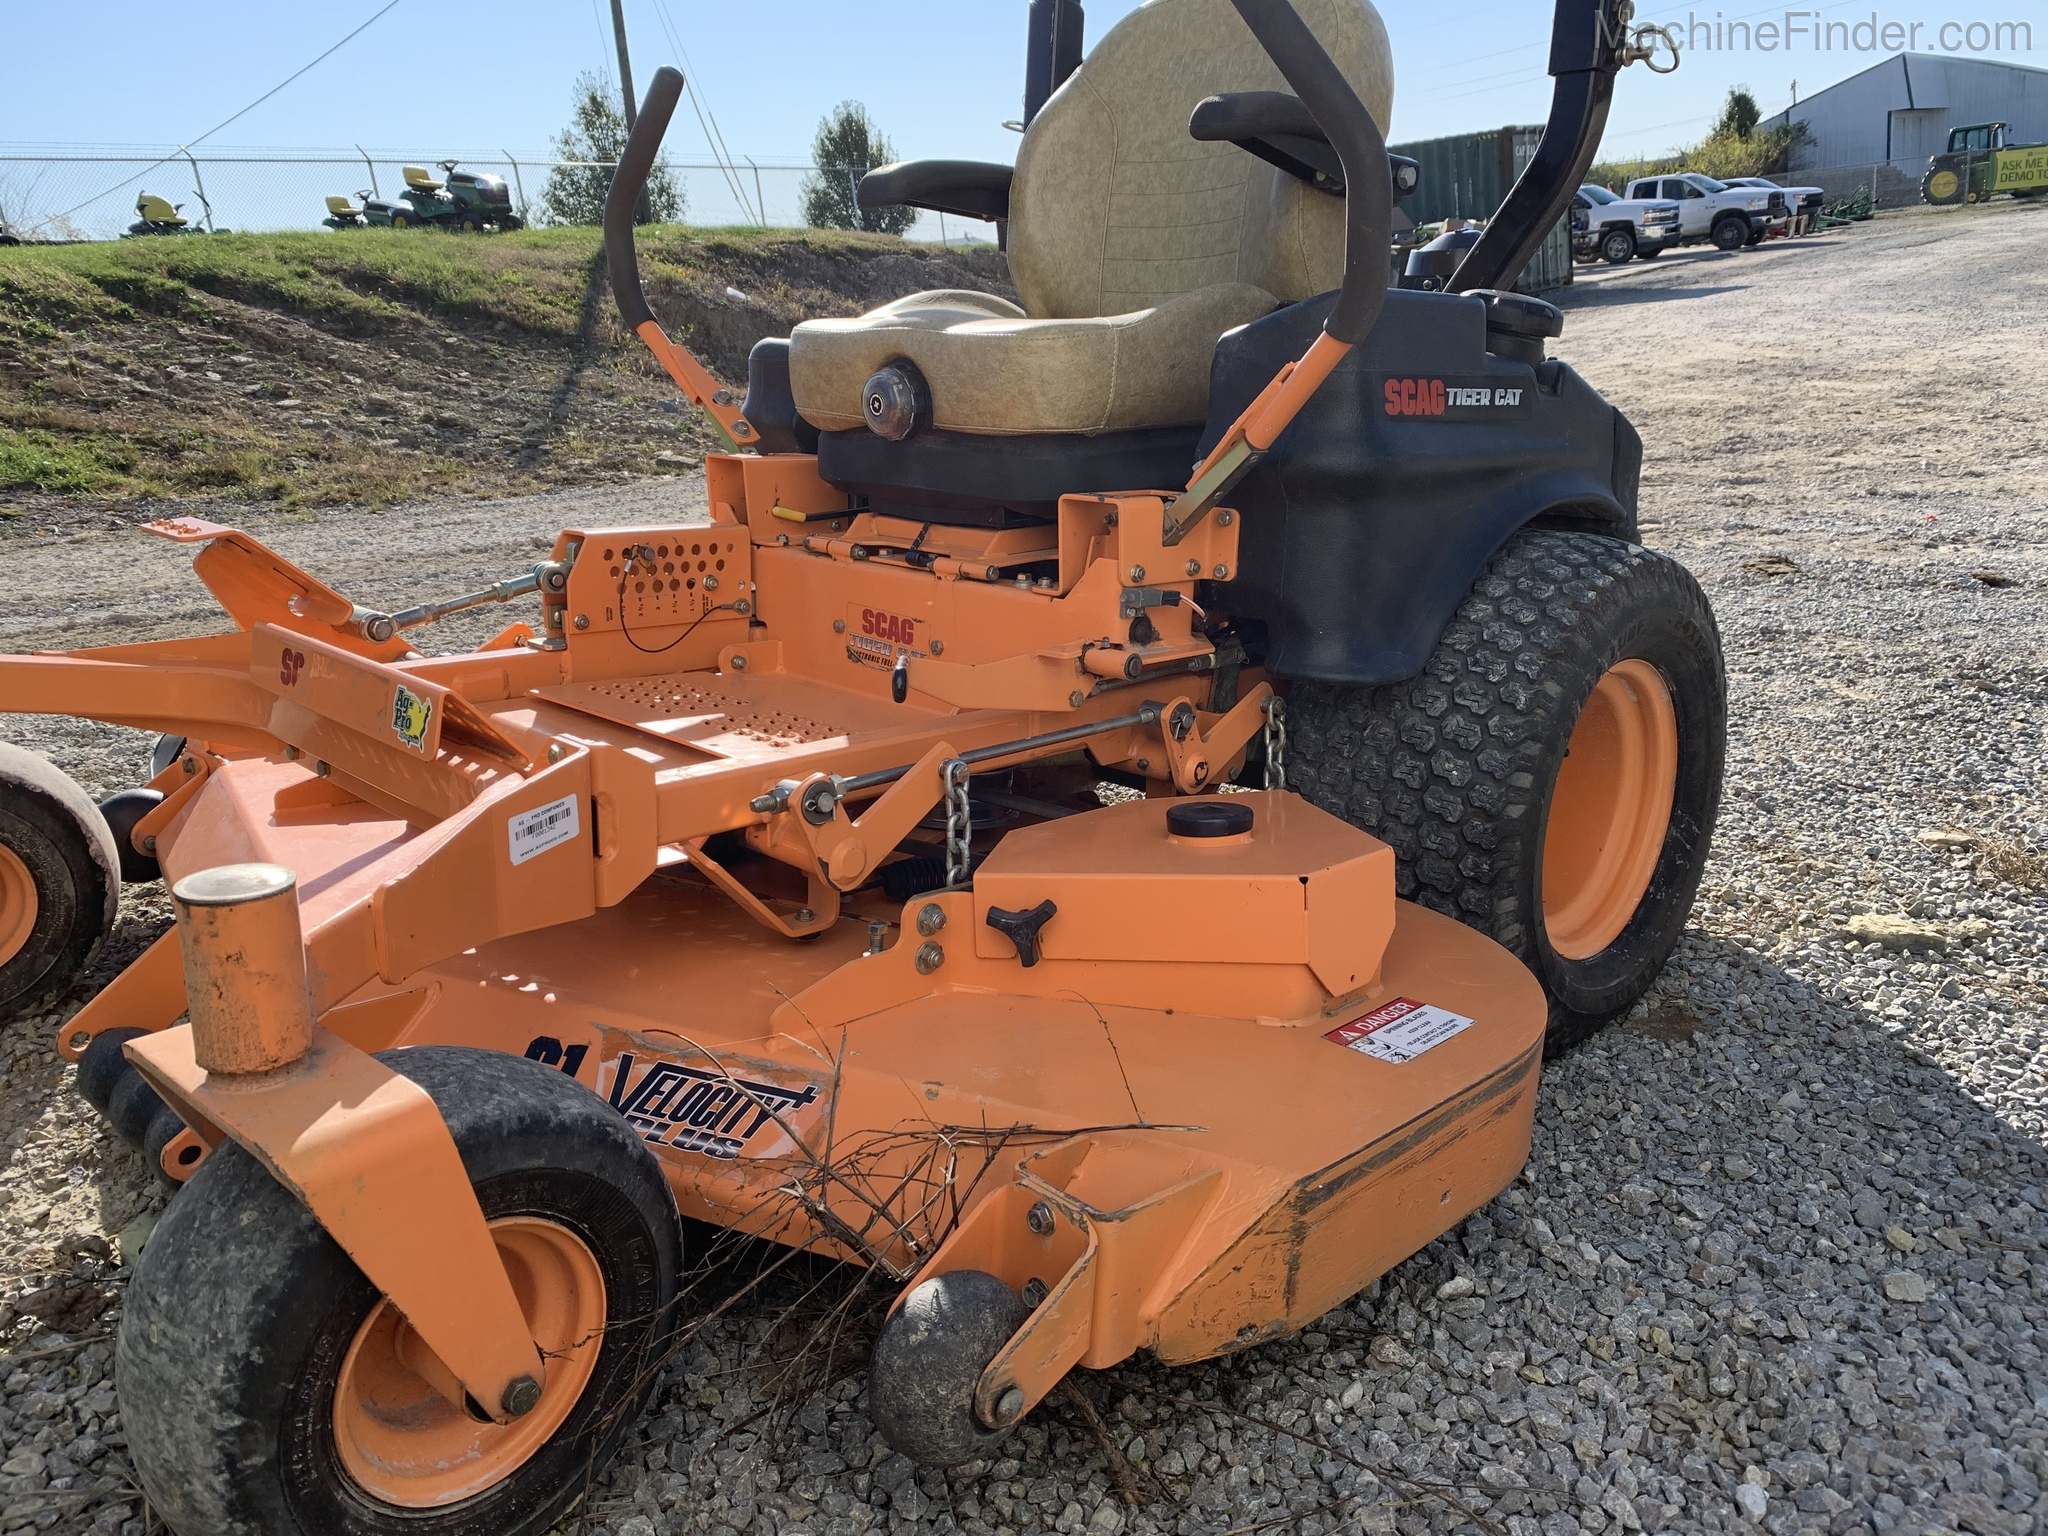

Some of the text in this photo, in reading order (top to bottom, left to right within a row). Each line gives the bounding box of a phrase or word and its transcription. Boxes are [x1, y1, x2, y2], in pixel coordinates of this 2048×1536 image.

[2000, 171, 2034, 183] DEMO
[2001, 160, 2023, 171] ASK
[2025, 157, 2044, 168] ME
[1384, 378, 1523, 416] SCAG TIGER CAT
[862, 608, 914, 646] SCAG
[849, 632, 893, 656] TIGER
[394, 686, 414, 714] Ag-
[393, 708, 411, 731] Pro
[531, 812, 541, 821] PRO
[541, 801, 565, 815] COMPANIES
[1354, 1002, 1415, 1031] DANGER
[624, 1115, 746, 1161] PLUS
